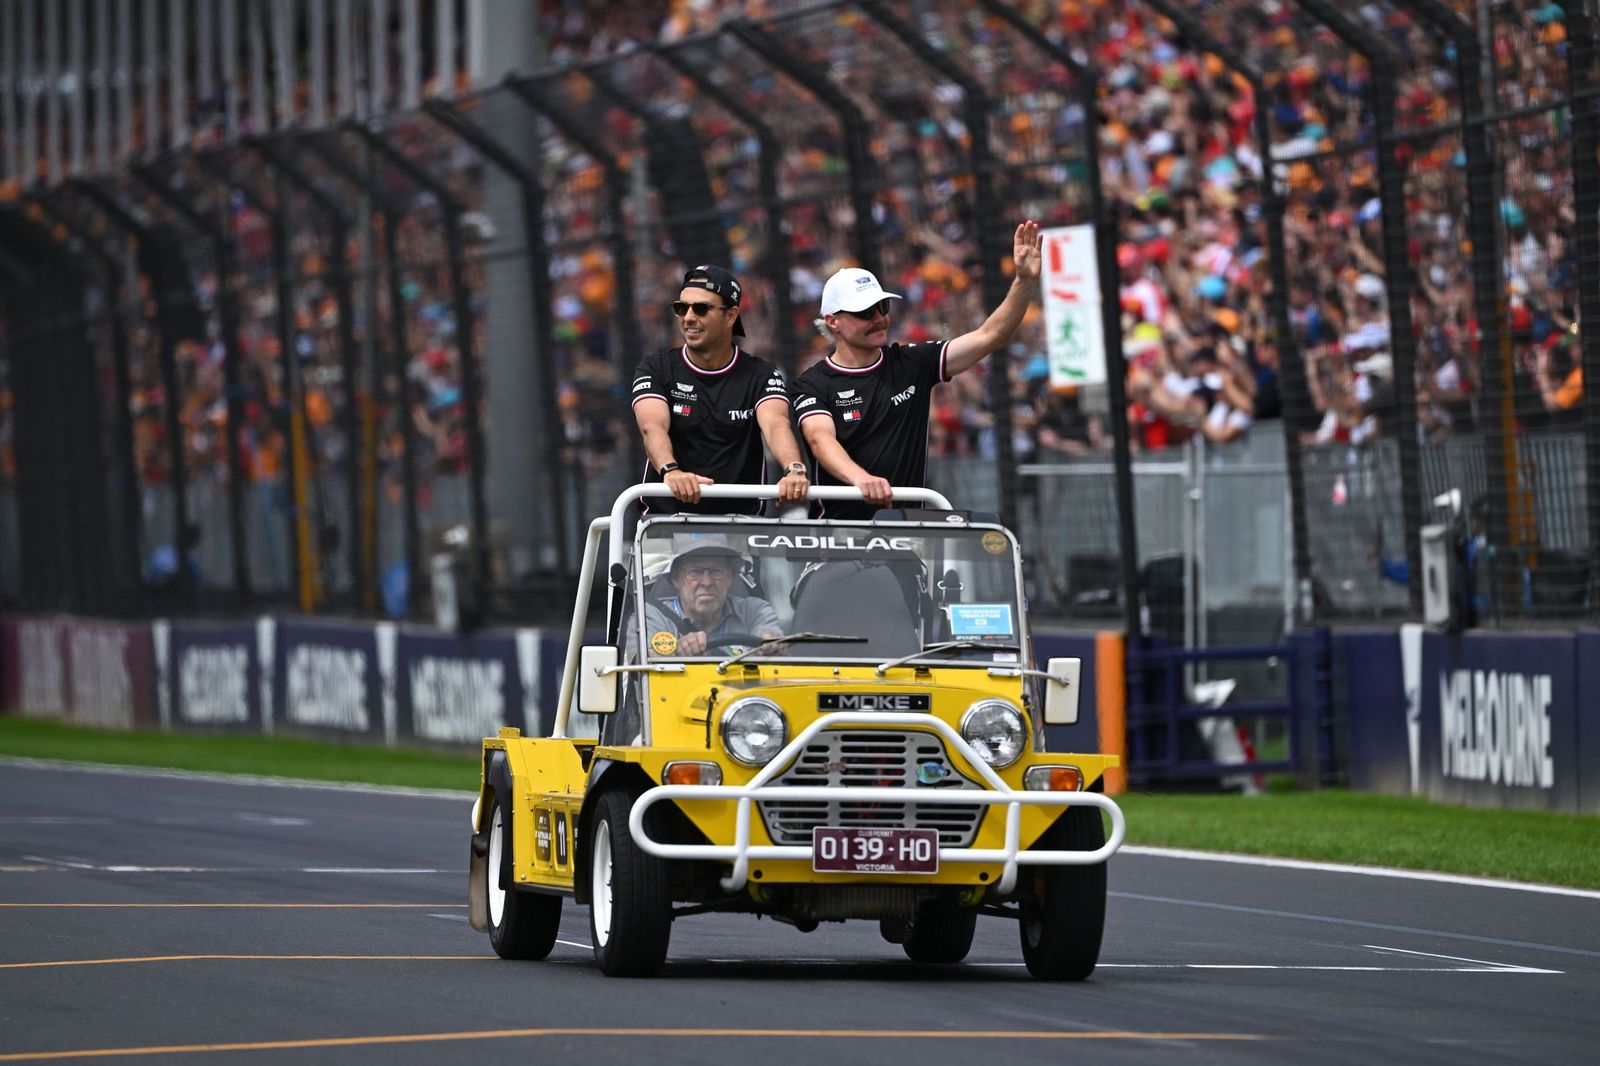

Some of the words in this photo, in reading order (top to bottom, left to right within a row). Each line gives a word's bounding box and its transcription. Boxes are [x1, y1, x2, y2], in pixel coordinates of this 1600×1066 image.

[747, 535, 913, 551] CADILLAC
[838, 695, 910, 710] MOKE
[1439, 669, 1554, 788] MELBOURNE
[855, 863, 896, 872] VICTORIA
